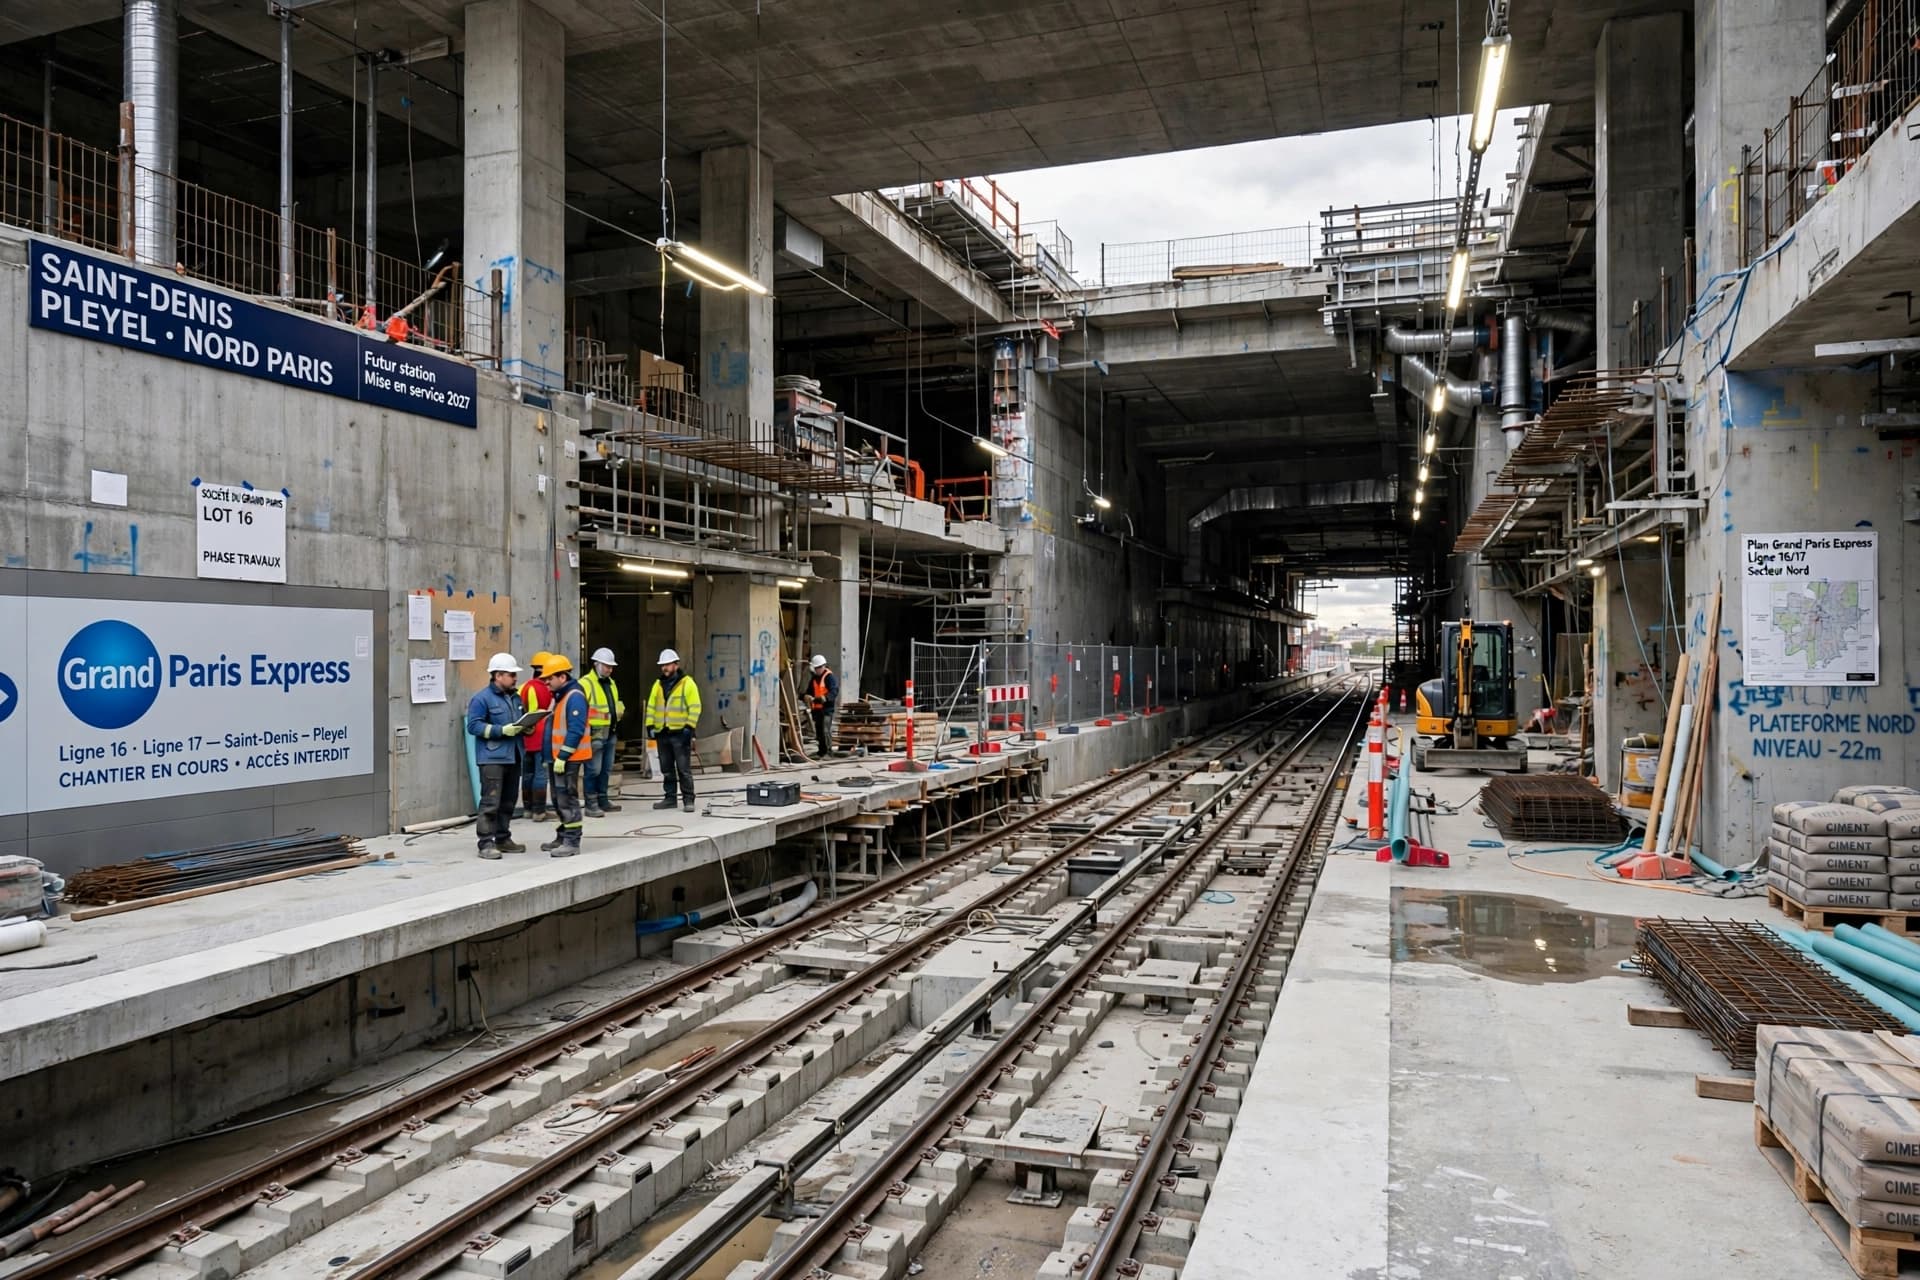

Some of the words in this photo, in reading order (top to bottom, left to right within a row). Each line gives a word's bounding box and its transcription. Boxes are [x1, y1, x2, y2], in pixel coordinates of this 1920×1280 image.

[41, 253, 233, 330] SAINT-DENIS
[41, 289, 156, 345] PLEYEL
[184, 326, 259, 368] NORD
[267, 347, 333, 386] PARIS
[365, 351, 397, 373] Futur
[400, 362, 436, 383] station
[365, 370, 391, 390] Mise
[394, 382, 407, 394] en
[410, 387, 445, 403] service
[447, 391, 471, 410] 2027
[203, 506, 233, 523] LOT
[238, 510, 253, 525] 16
[1747, 539, 1769, 550] Plan
[1772, 539, 1802, 549] Grand
[1805, 539, 1831, 549] Paris
[1833, 539, 1873, 550] Express
[203, 551, 236, 564] PHASE
[237, 553, 281, 568] TRAVAUX
[1778, 552, 1806, 562] 16/17
[1747, 564, 1783, 576] Secteur
[1786, 565, 1810, 576] Nord
[63, 656, 154, 690] Grand
[169, 654, 241, 688] Paris
[251, 654, 350, 692] Express
[1749, 713, 1860, 733] PLATEFORME
[1867, 714, 1916, 734] NORD
[60, 744, 105, 765] Ligne
[111, 742, 127, 758] 16
[144, 738, 183, 757] Ligne
[188, 736, 202, 751] 17
[224, 729, 298, 749] Saint-Denis
[313, 726, 348, 745] Pleyel
[1753, 738, 1821, 758] NIVEAU
[59, 766, 145, 788] CHANTIER
[151, 763, 172, 779] EN
[177, 758, 228, 776] COURS
[246, 750, 289, 770] ACCÈS
[294, 747, 350, 765] INTERDIT
[1826, 823, 1870, 833] CIMENT
[1828, 841, 1872, 851] CIMENT
[1826, 859, 1870, 869] CIMENT
[1827, 877, 1872, 887] CIMENT
[1827, 894, 1871, 905] CIMENT
[1885, 1141, 1920, 1157] CIME
